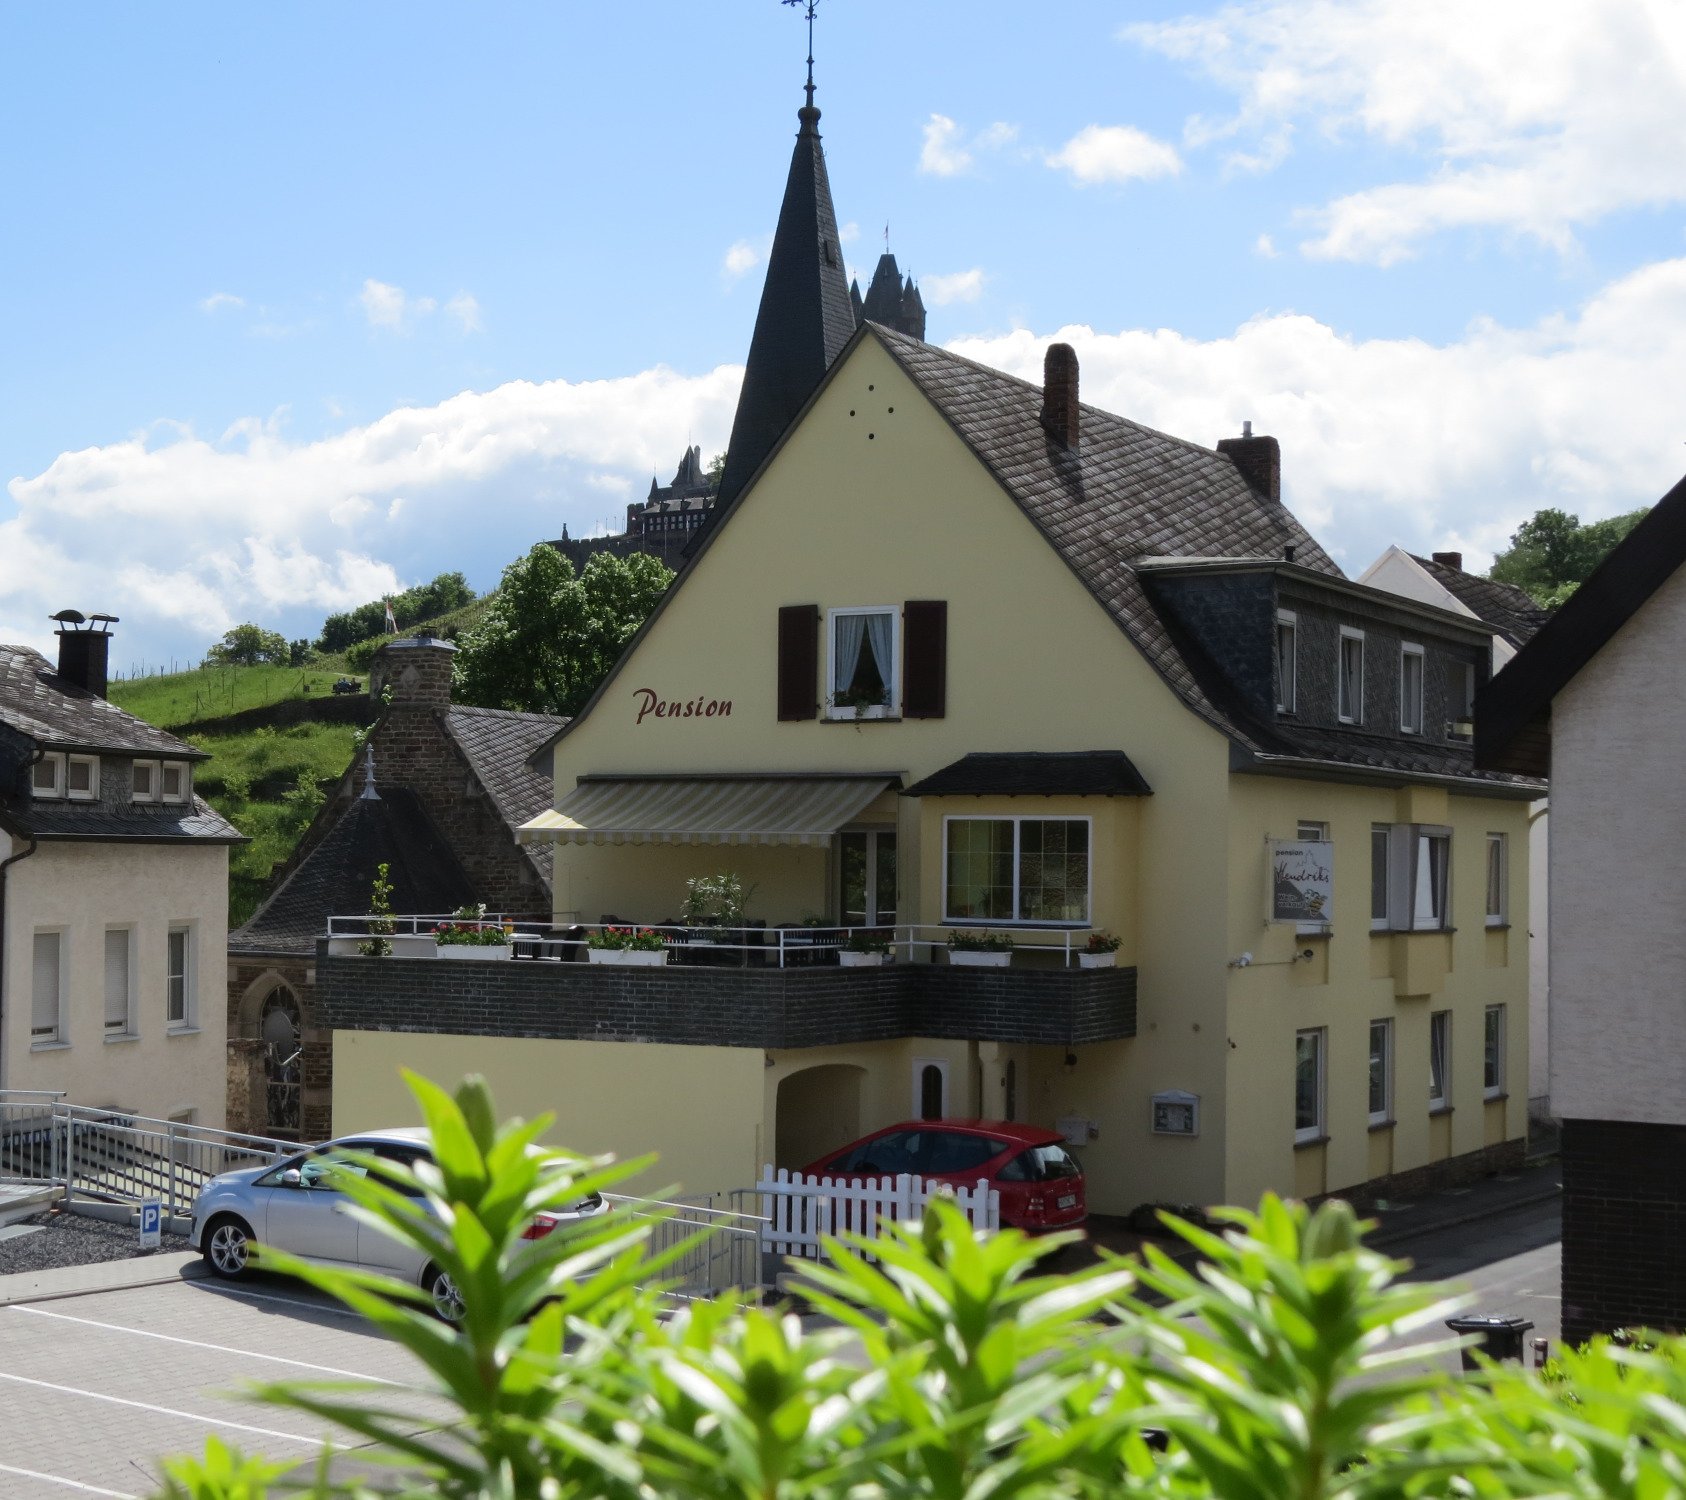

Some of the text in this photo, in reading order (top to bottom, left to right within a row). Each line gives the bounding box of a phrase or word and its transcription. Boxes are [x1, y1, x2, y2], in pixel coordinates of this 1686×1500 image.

[633, 688, 732, 724] Pension
[1275, 849, 1304, 857] pension
[145, 1209, 157, 1229] P
